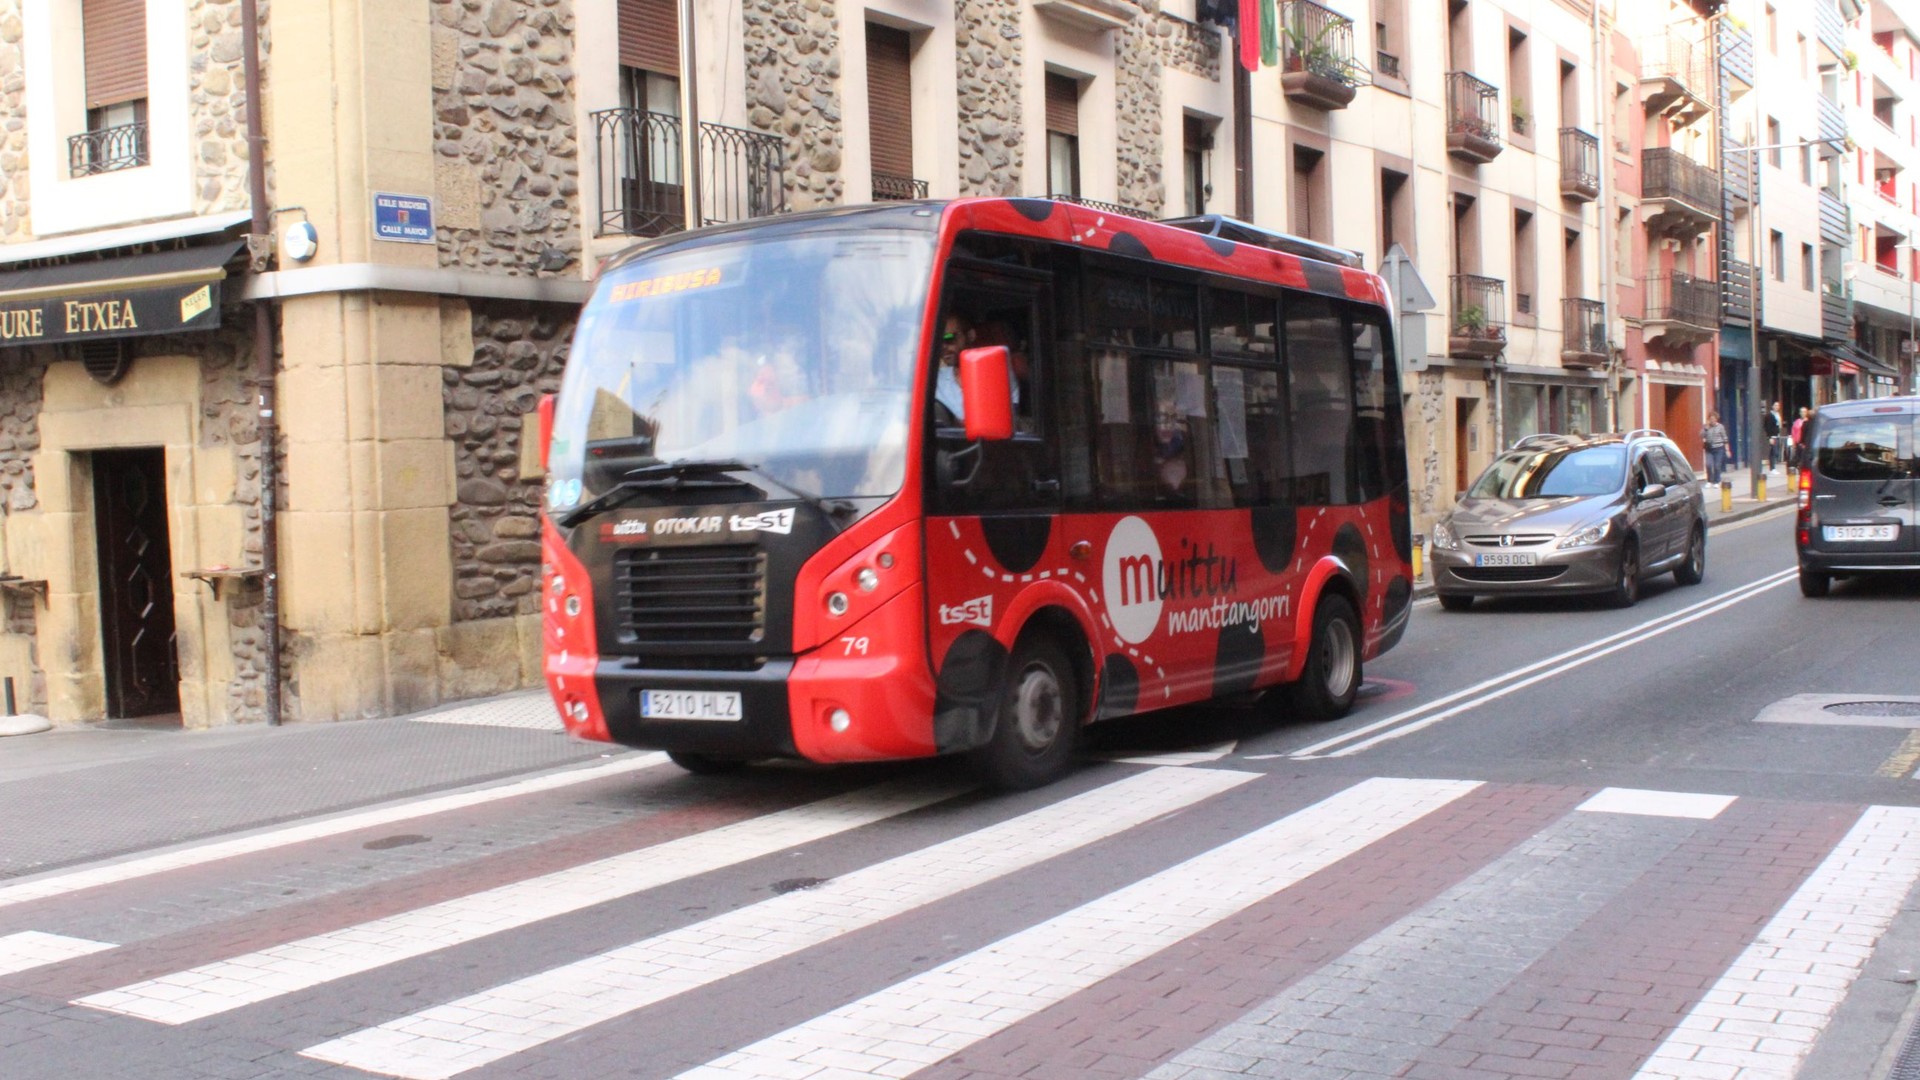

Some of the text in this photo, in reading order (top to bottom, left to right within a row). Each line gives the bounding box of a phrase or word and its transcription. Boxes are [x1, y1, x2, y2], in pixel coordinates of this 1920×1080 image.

[609, 267, 721, 303] HIRIBUSA
[0, 309, 43, 339] URE
[653, 515, 723, 535] OTOKAR
[728, 512, 791, 532] tsst
[1837, 527, 1864, 538] 5102
[1119, 537, 1237, 606] muittu
[1483, 555, 1510, 565] 9593
[938, 598, 990, 625] tsst
[1168, 584, 1291, 637] manttangorri
[840, 636, 869, 655] 79
[652, 693, 737, 717] 5210 HLZ
